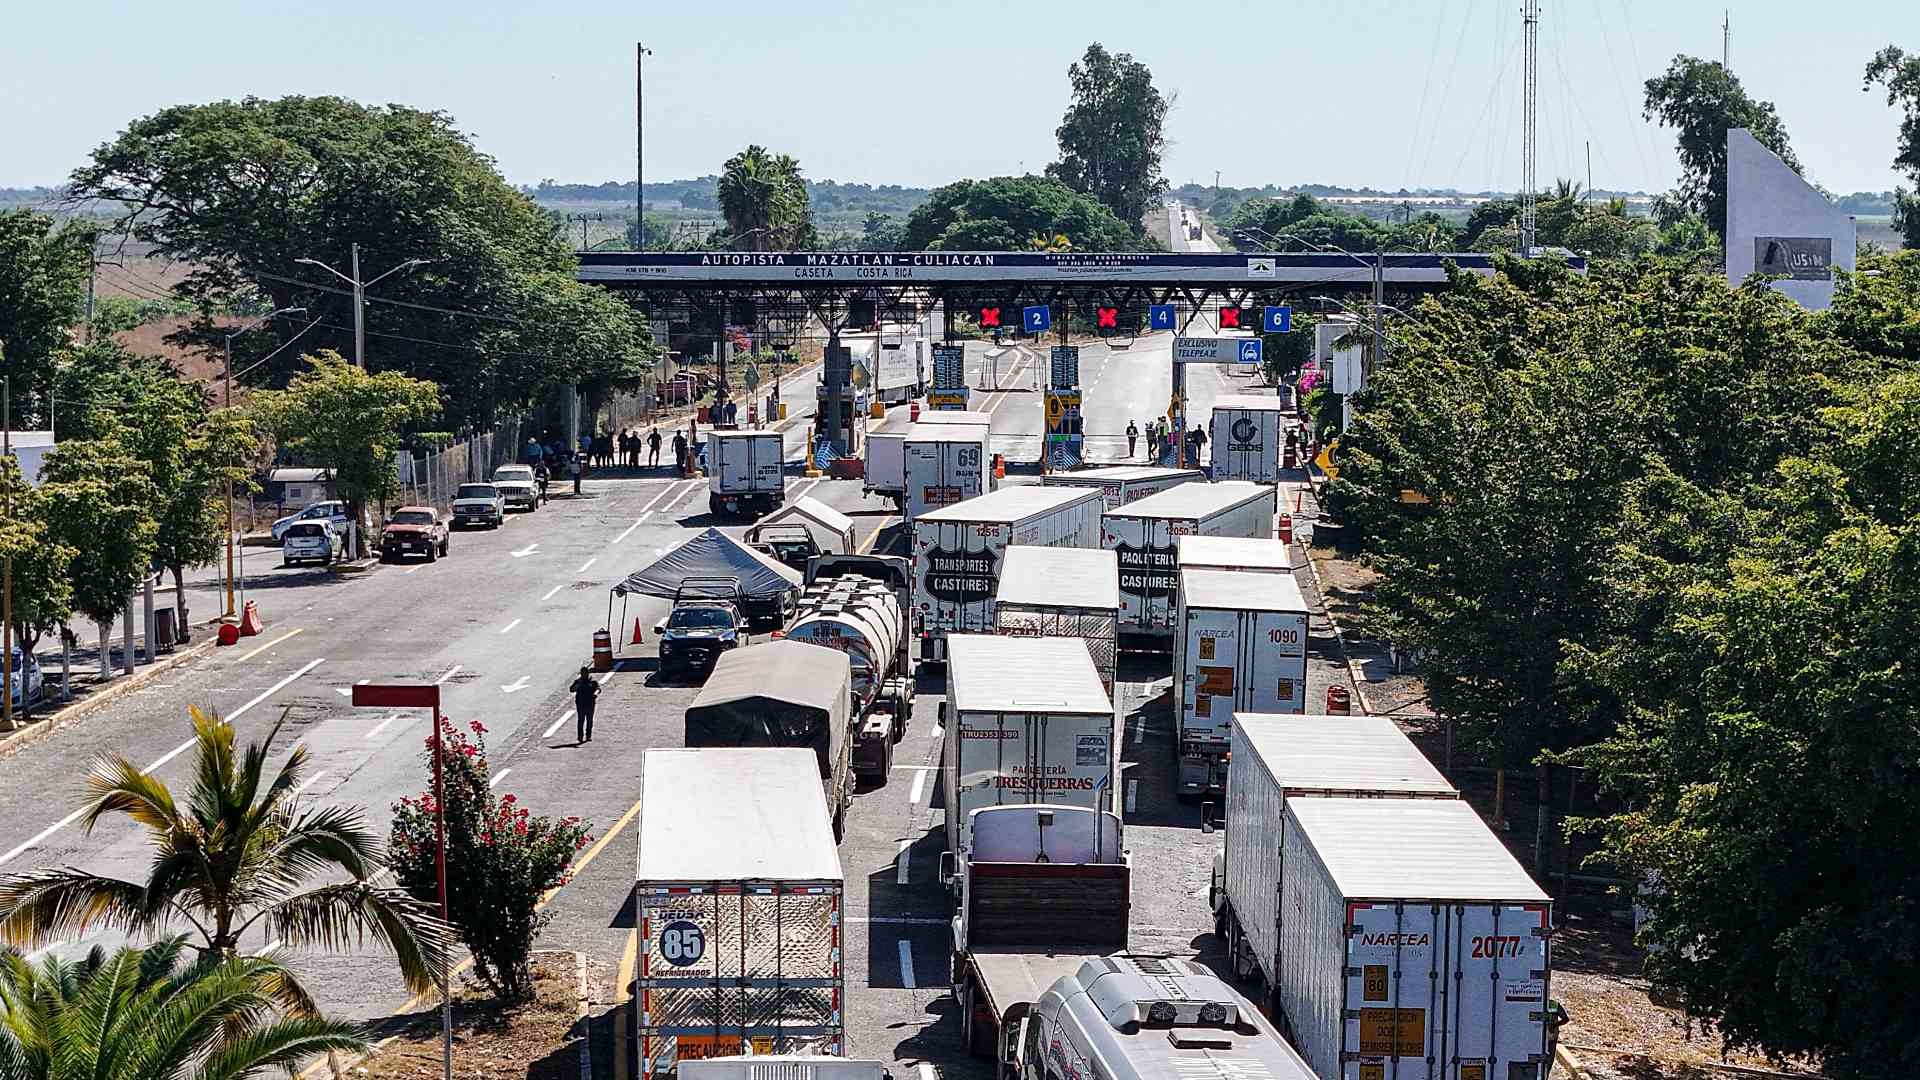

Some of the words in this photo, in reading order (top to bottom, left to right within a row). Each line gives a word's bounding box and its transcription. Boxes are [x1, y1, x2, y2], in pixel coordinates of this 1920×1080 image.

[702, 255, 785, 265] AUTOPISTA
[807, 255, 893, 265] MAZATLAN
[914, 255, 995, 265] CULIACAN
[794, 268, 833, 278] CASETA
[857, 268, 888, 278] COSTA
[895, 268, 913, 278] RICA
[1033, 312, 1042, 325] 2
[1159, 311, 1167, 323] 4
[1273, 313, 1282, 325] 6
[1178, 340, 1218, 348] EXCLUSIVO
[1178, 349, 1217, 358] TELEPEAJE
[958, 448, 979, 467] 69
[976, 527, 1000, 537] 12515
[1165, 526, 1189, 535] 12050
[1121, 552, 1175, 566] PAQUETERIA
[934, 558, 989, 573] TRANSPORTES
[934, 577, 989, 592] CASTORES
[1121, 575, 1177, 589] CASTORES
[1194, 629, 1235, 639] NARCEA
[1268, 629, 1298, 643] 1090
[993, 776, 1094, 790] TRESGUERRAS
[664, 929, 701, 959] 85
[1361, 933, 1429, 946] NARCEA
[1471, 935, 1520, 959] 2077
[656, 969, 711, 977] REFRIGERADOS
[1368, 980, 1384, 992] 80
